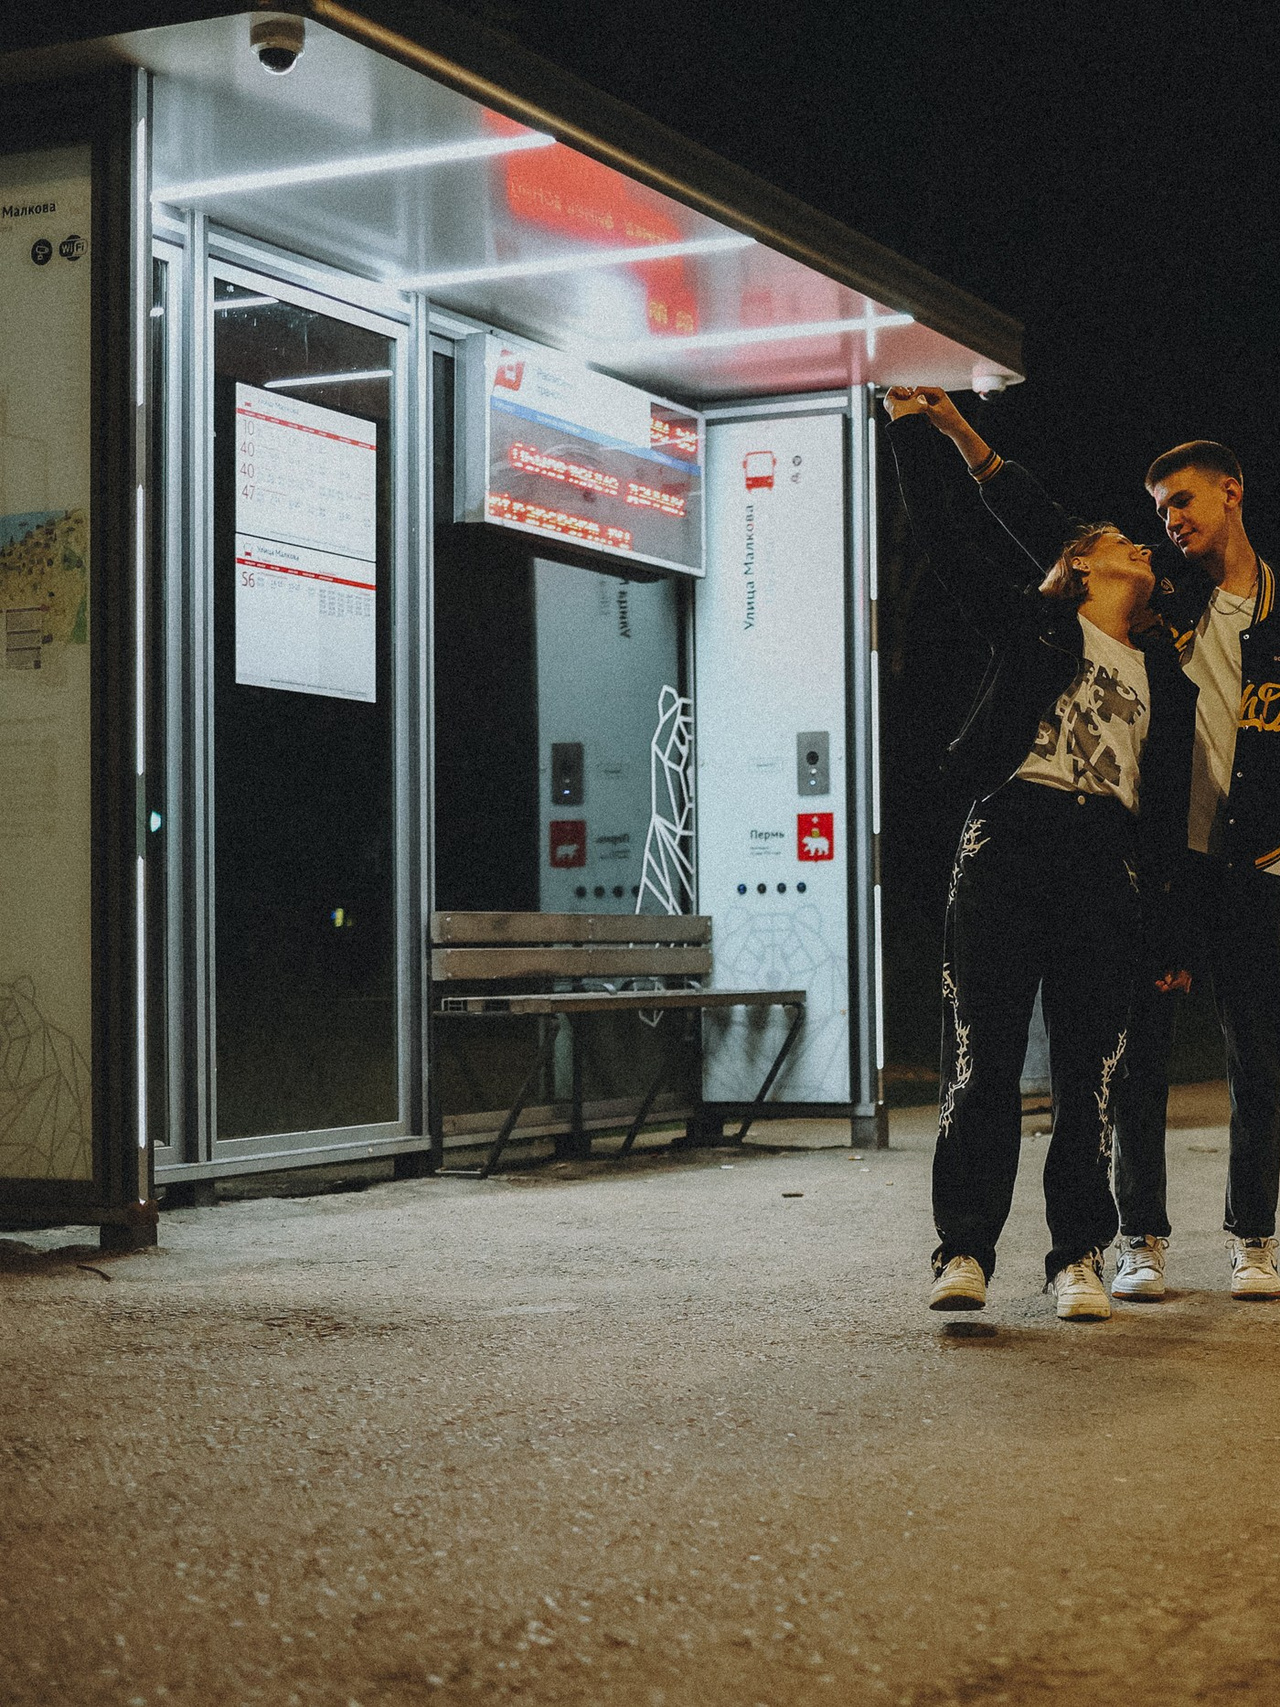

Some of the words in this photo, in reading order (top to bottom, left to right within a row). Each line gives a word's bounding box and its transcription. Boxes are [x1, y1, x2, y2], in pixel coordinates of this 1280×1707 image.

[2, 202, 56, 218] Малкова
[240, 441, 255, 457] 40
[240, 463, 255, 479] 40
[242, 485, 256, 501] 47
[744, 505, 755, 575] Малкова
[242, 571, 256, 588] 56
[744, 581, 757, 630] Улица
[750, 829, 785, 841] Пермь
